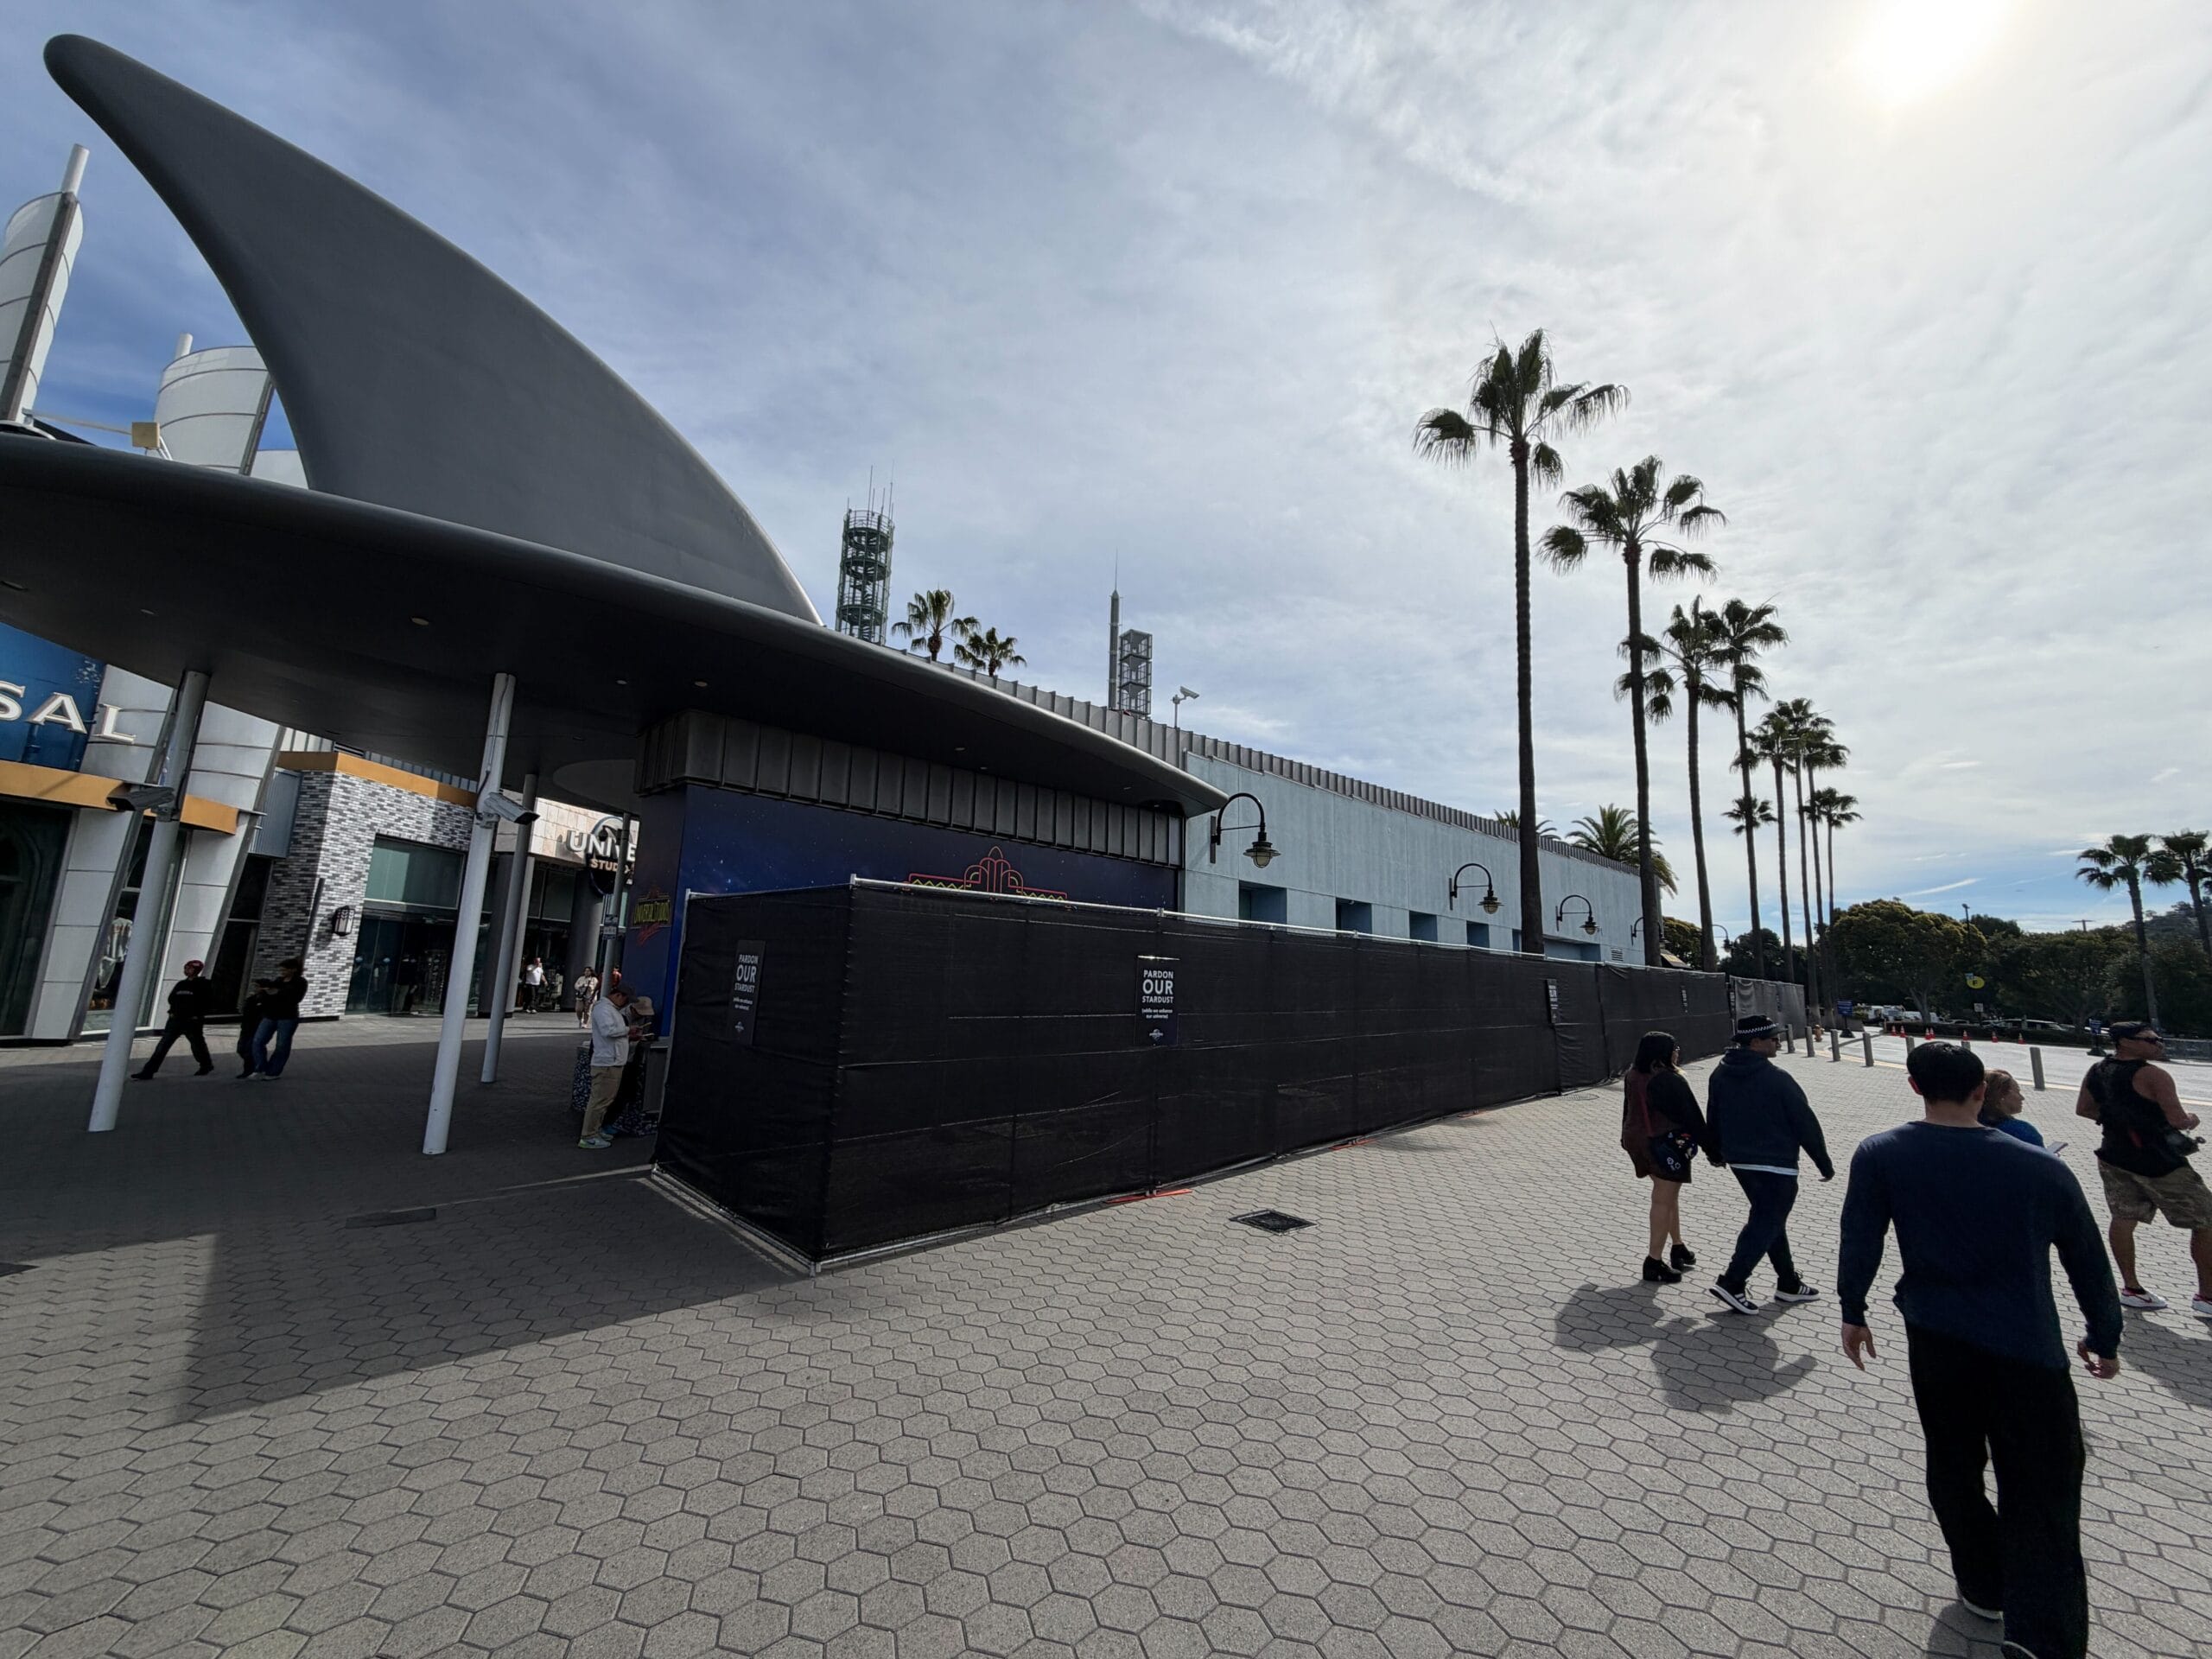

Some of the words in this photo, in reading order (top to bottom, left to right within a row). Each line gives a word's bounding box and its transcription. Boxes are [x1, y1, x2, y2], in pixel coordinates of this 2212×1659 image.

[0, 680, 137, 744] SAL
[739, 954, 759, 964] PARDON
[736, 964, 757, 982] OUR
[1143, 969, 1174, 979] PARDON
[734, 982, 755, 994] STARDUST
[1142, 979, 1173, 995] OUR
